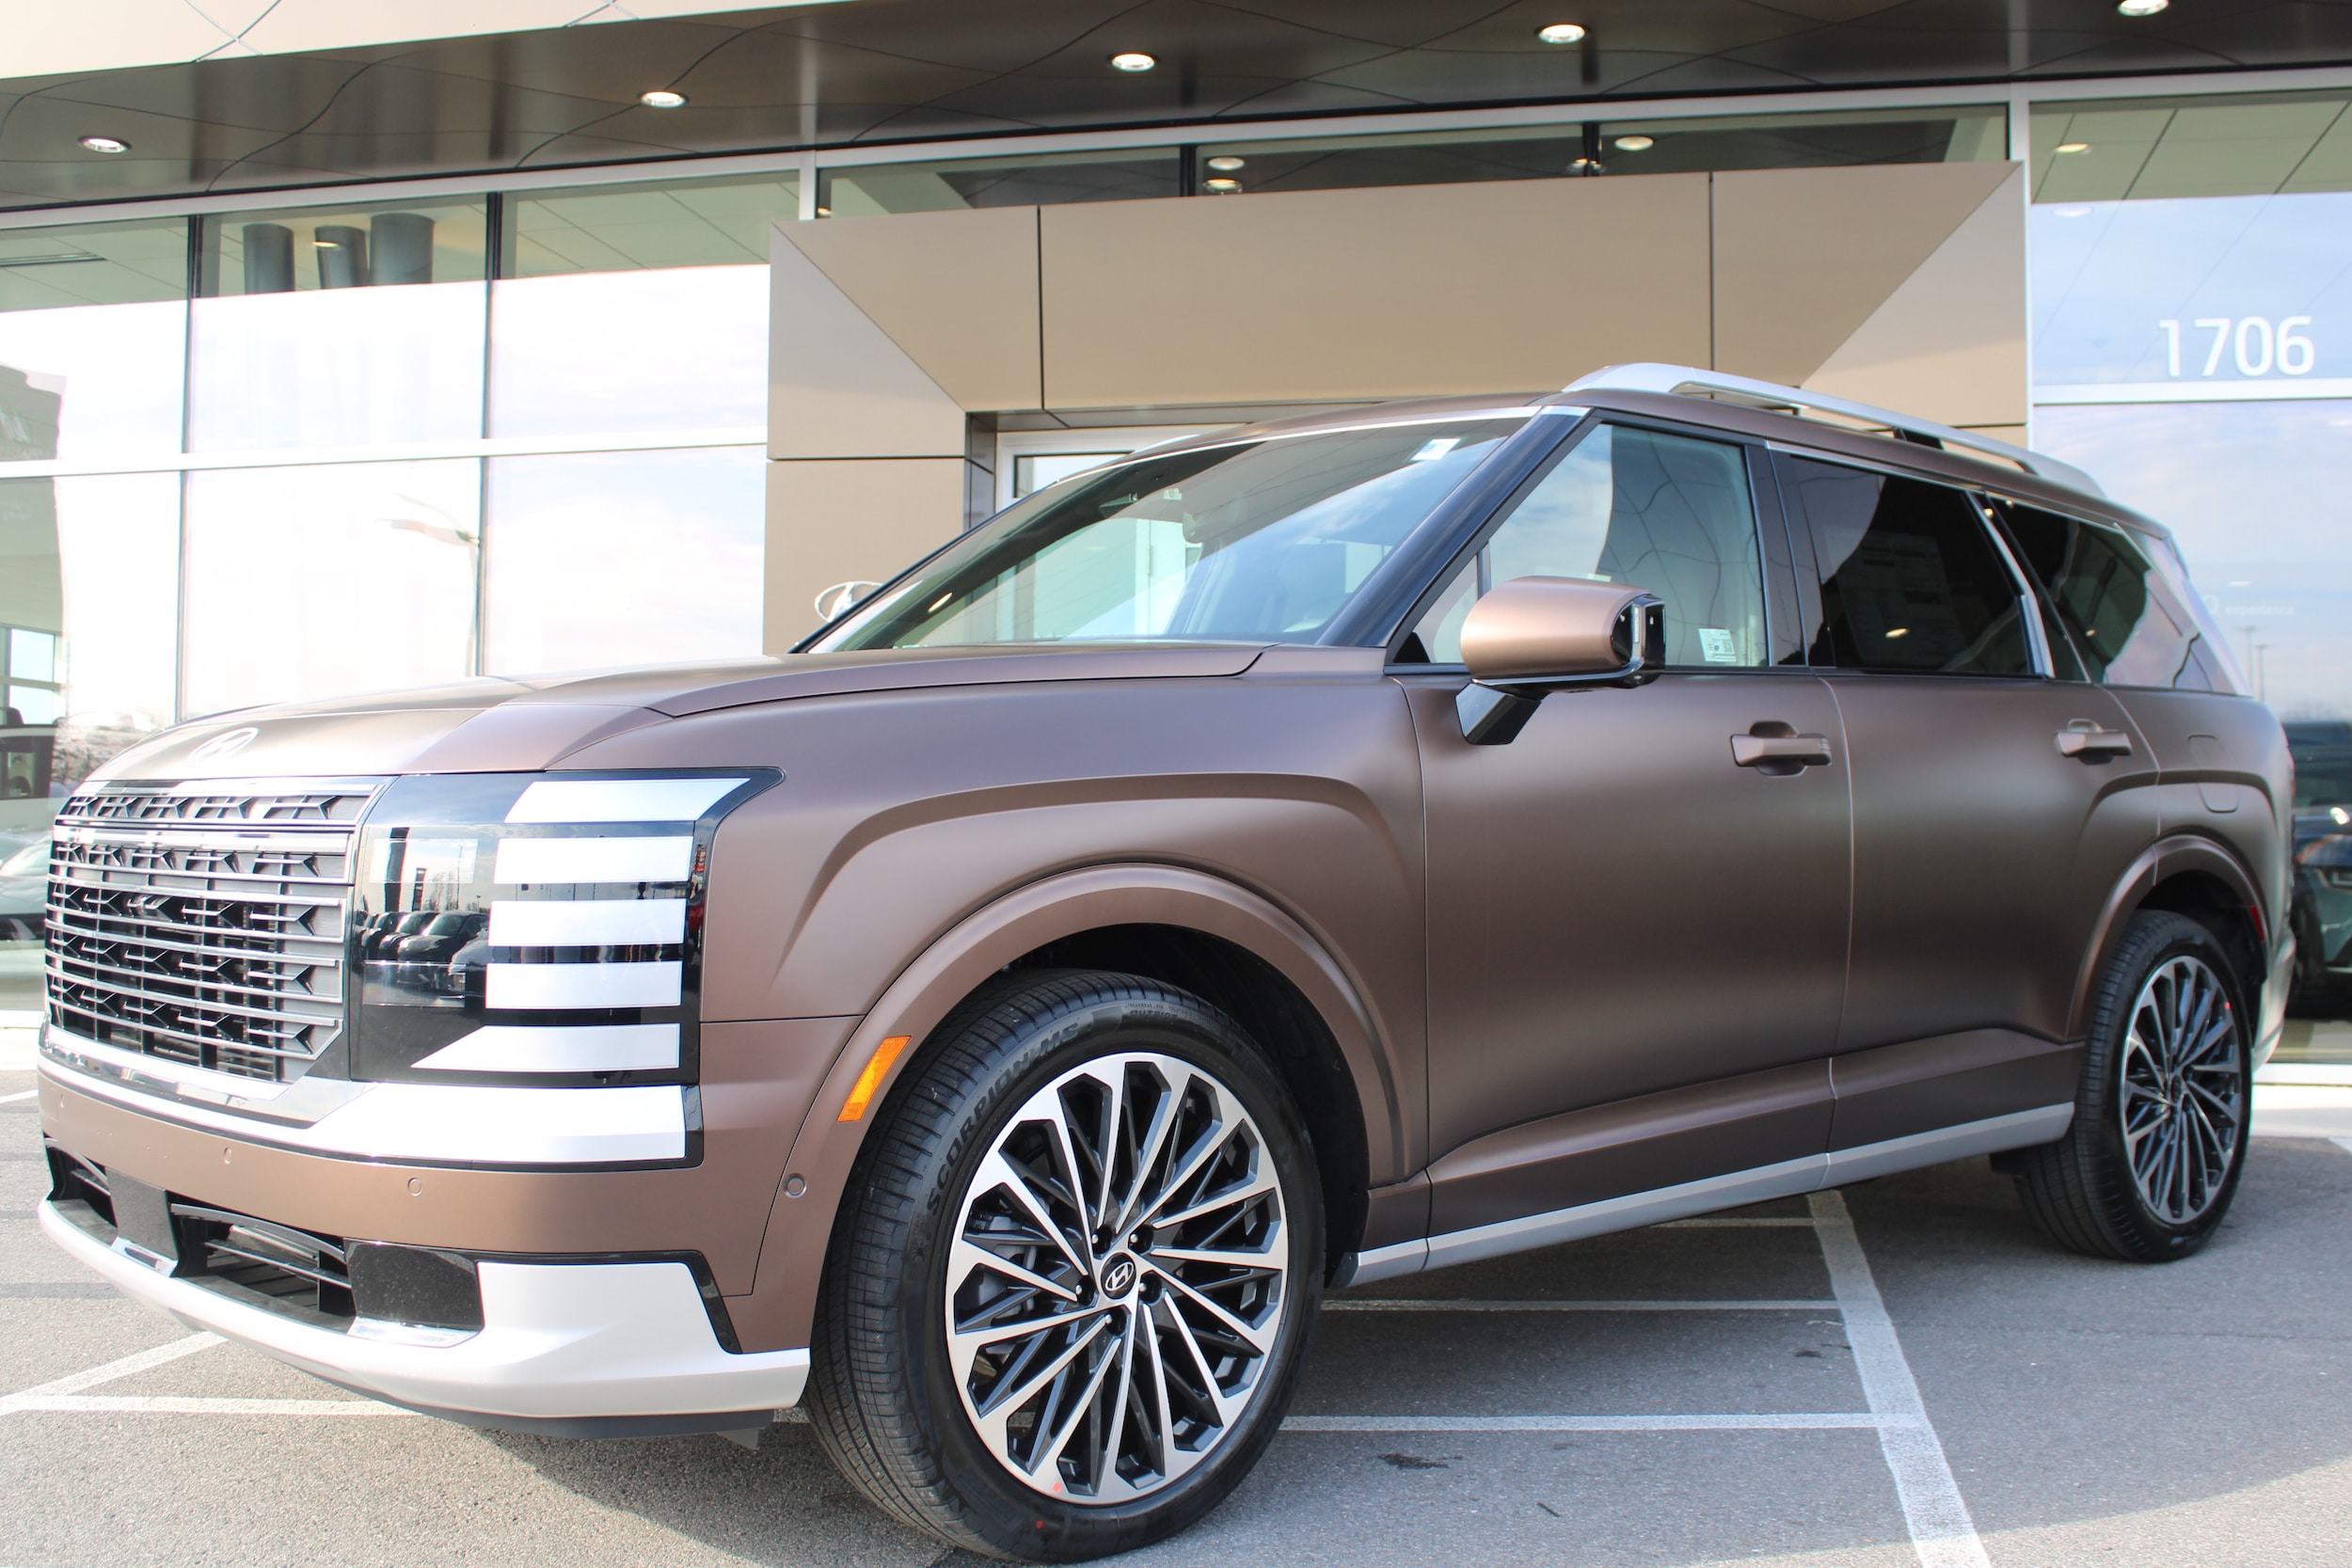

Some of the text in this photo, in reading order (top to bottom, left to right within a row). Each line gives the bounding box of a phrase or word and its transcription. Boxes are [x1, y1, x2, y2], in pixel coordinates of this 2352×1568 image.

[2159, 316, 2314, 377] 1706
[927, 1022, 1078, 1216] SCORPION MS
